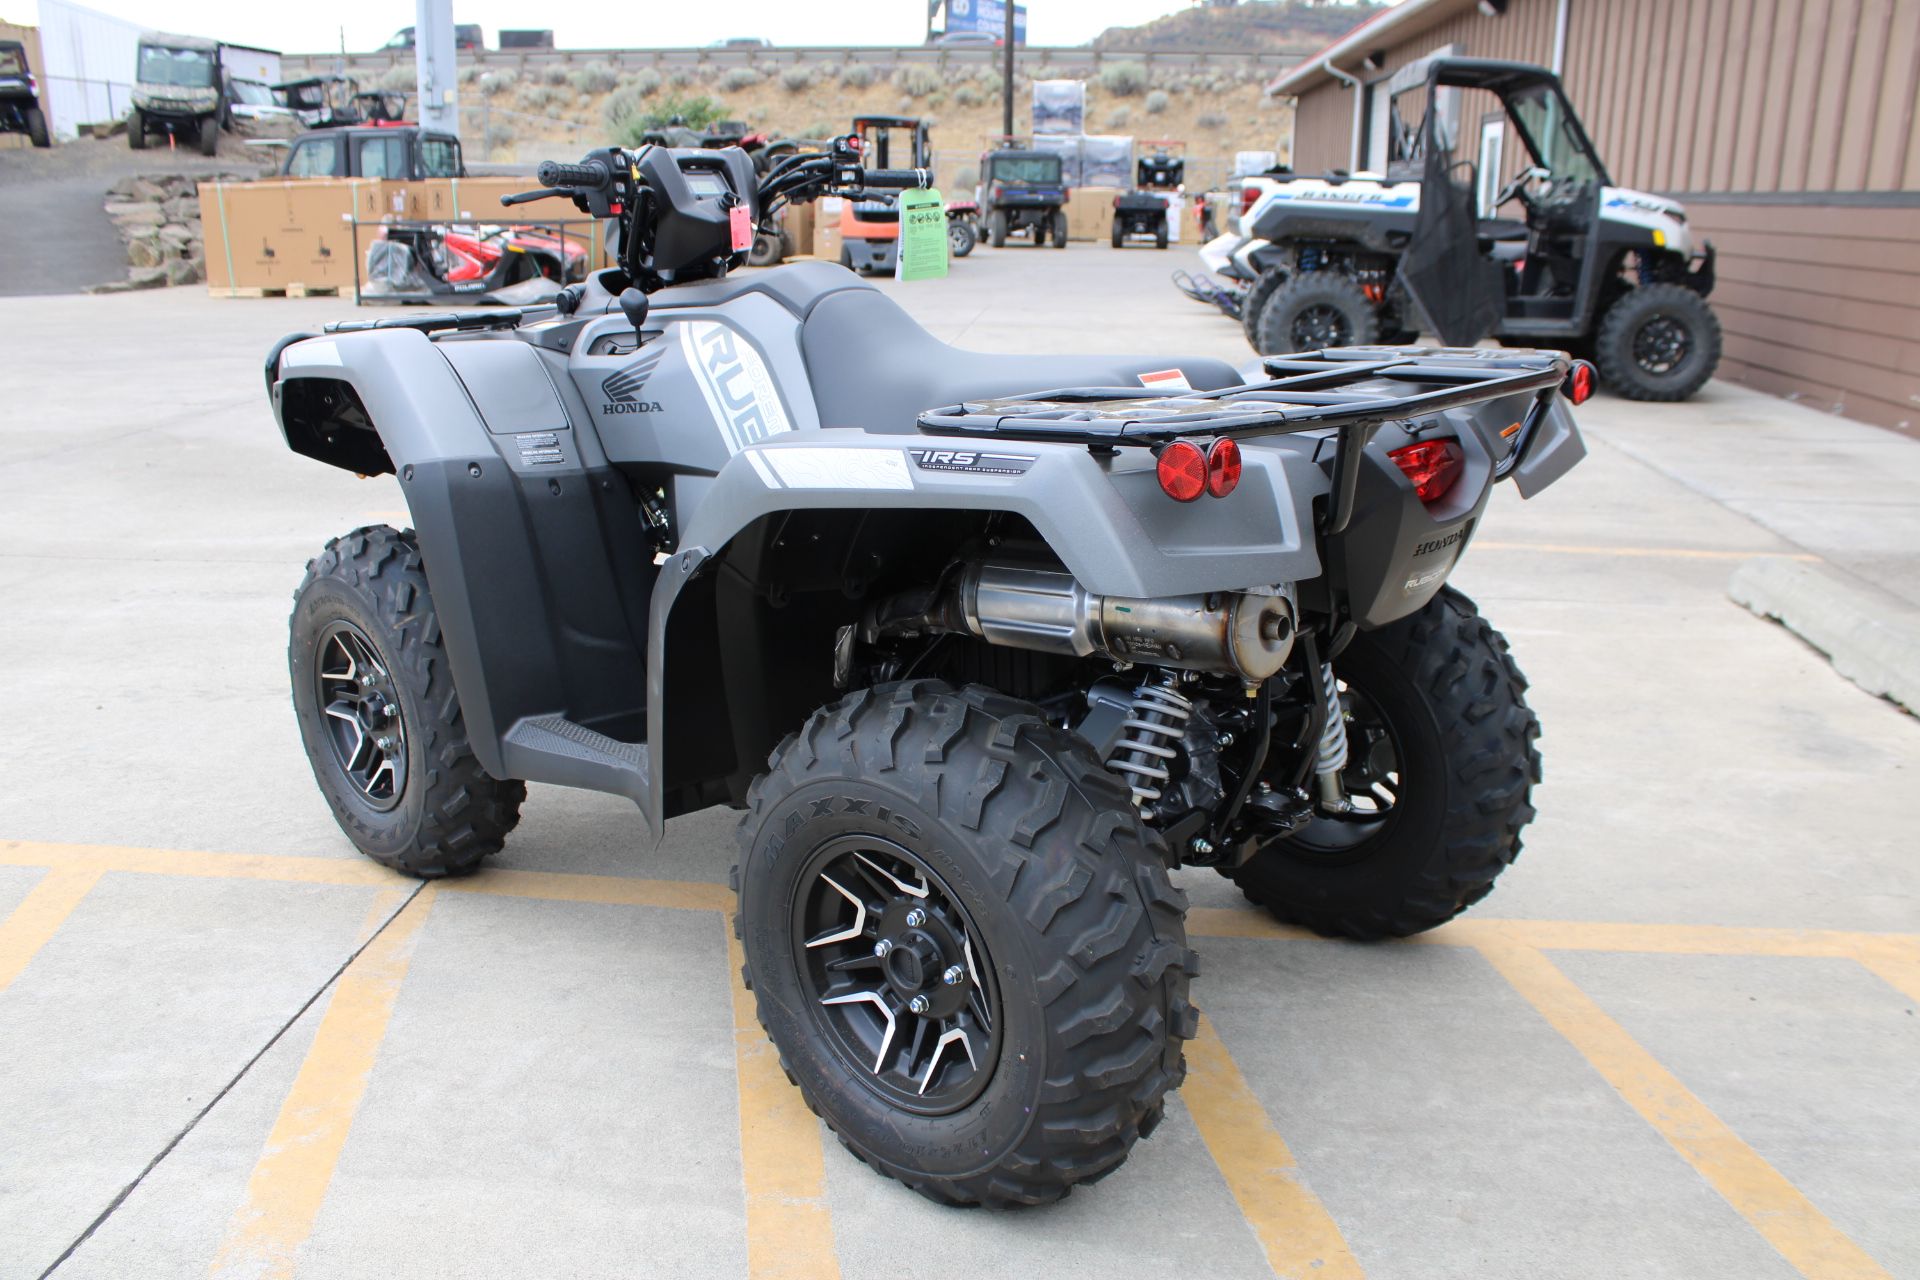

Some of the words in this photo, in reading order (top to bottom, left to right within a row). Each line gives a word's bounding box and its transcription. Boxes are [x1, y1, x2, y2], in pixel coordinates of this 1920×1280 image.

[602, 401, 664, 415] HONDA
[922, 450, 976, 465] IRS
[1412, 528, 1465, 557] HONDA
[763, 796, 922, 874] MAXXIS
